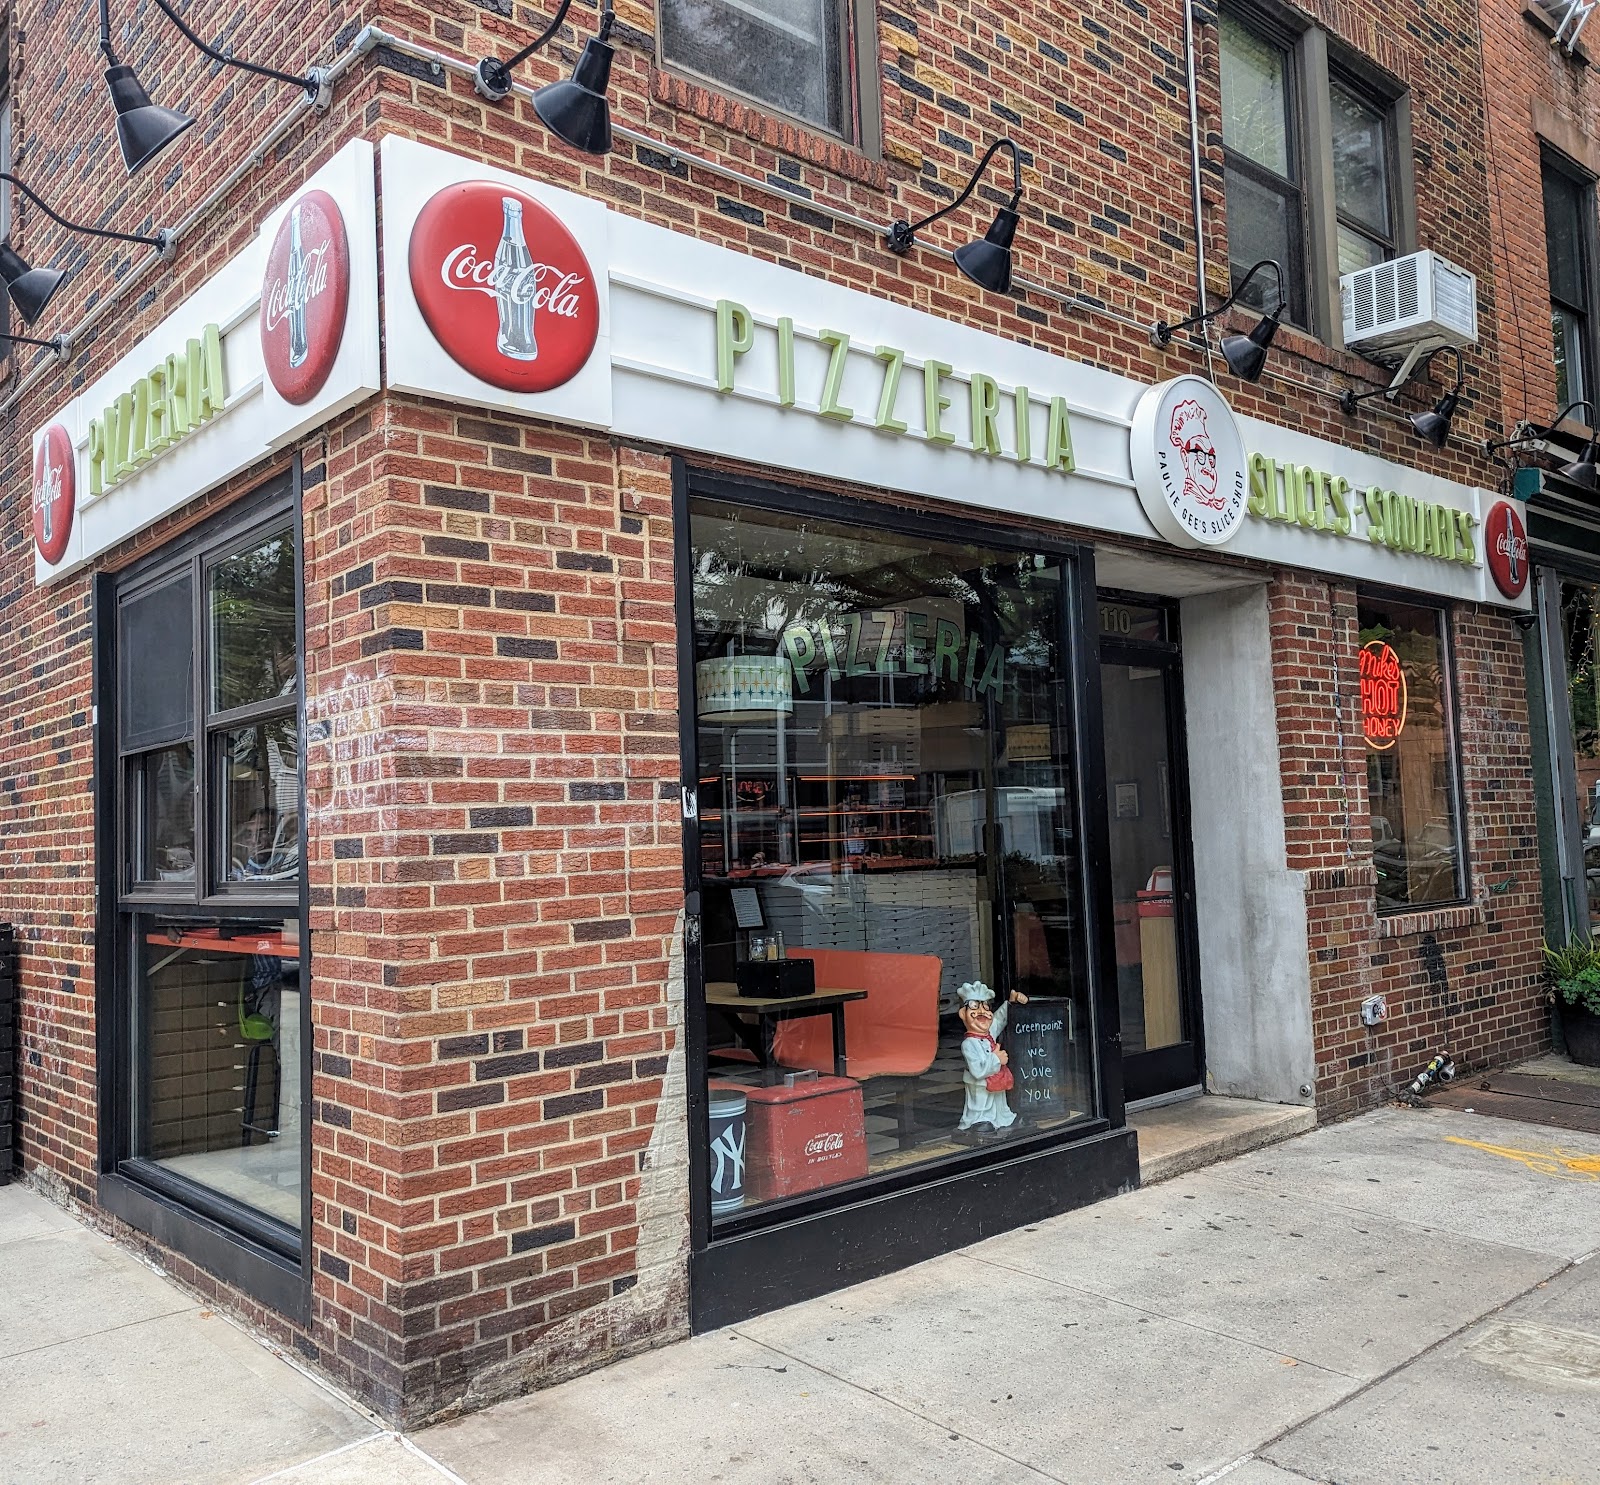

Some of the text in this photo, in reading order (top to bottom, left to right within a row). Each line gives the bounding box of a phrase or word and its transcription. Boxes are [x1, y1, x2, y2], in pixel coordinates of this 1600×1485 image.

[266, 237, 332, 332] Coca-Cola
[441, 243, 585, 318] Coca-Cola
[88, 322, 226, 497] PIZZERIA
[716, 299, 1076, 474] PIZZERIA
[1158, 451, 1244, 535] PAULIE GEE'S SLICE SHOP
[1247, 451, 1476, 565] SLICES SQUARES
[782, 609, 1005, 704] PIZZERIA
[1100, 606, 1131, 634] 110
[1359, 644, 1400, 681] Mike's
[1361, 678, 1400, 716] HOT
[1362, 717, 1400, 737] HONEY
[1015, 1020, 1063, 1038] Greenpoint
[804, 1132, 843, 1156] Coca-Cola
